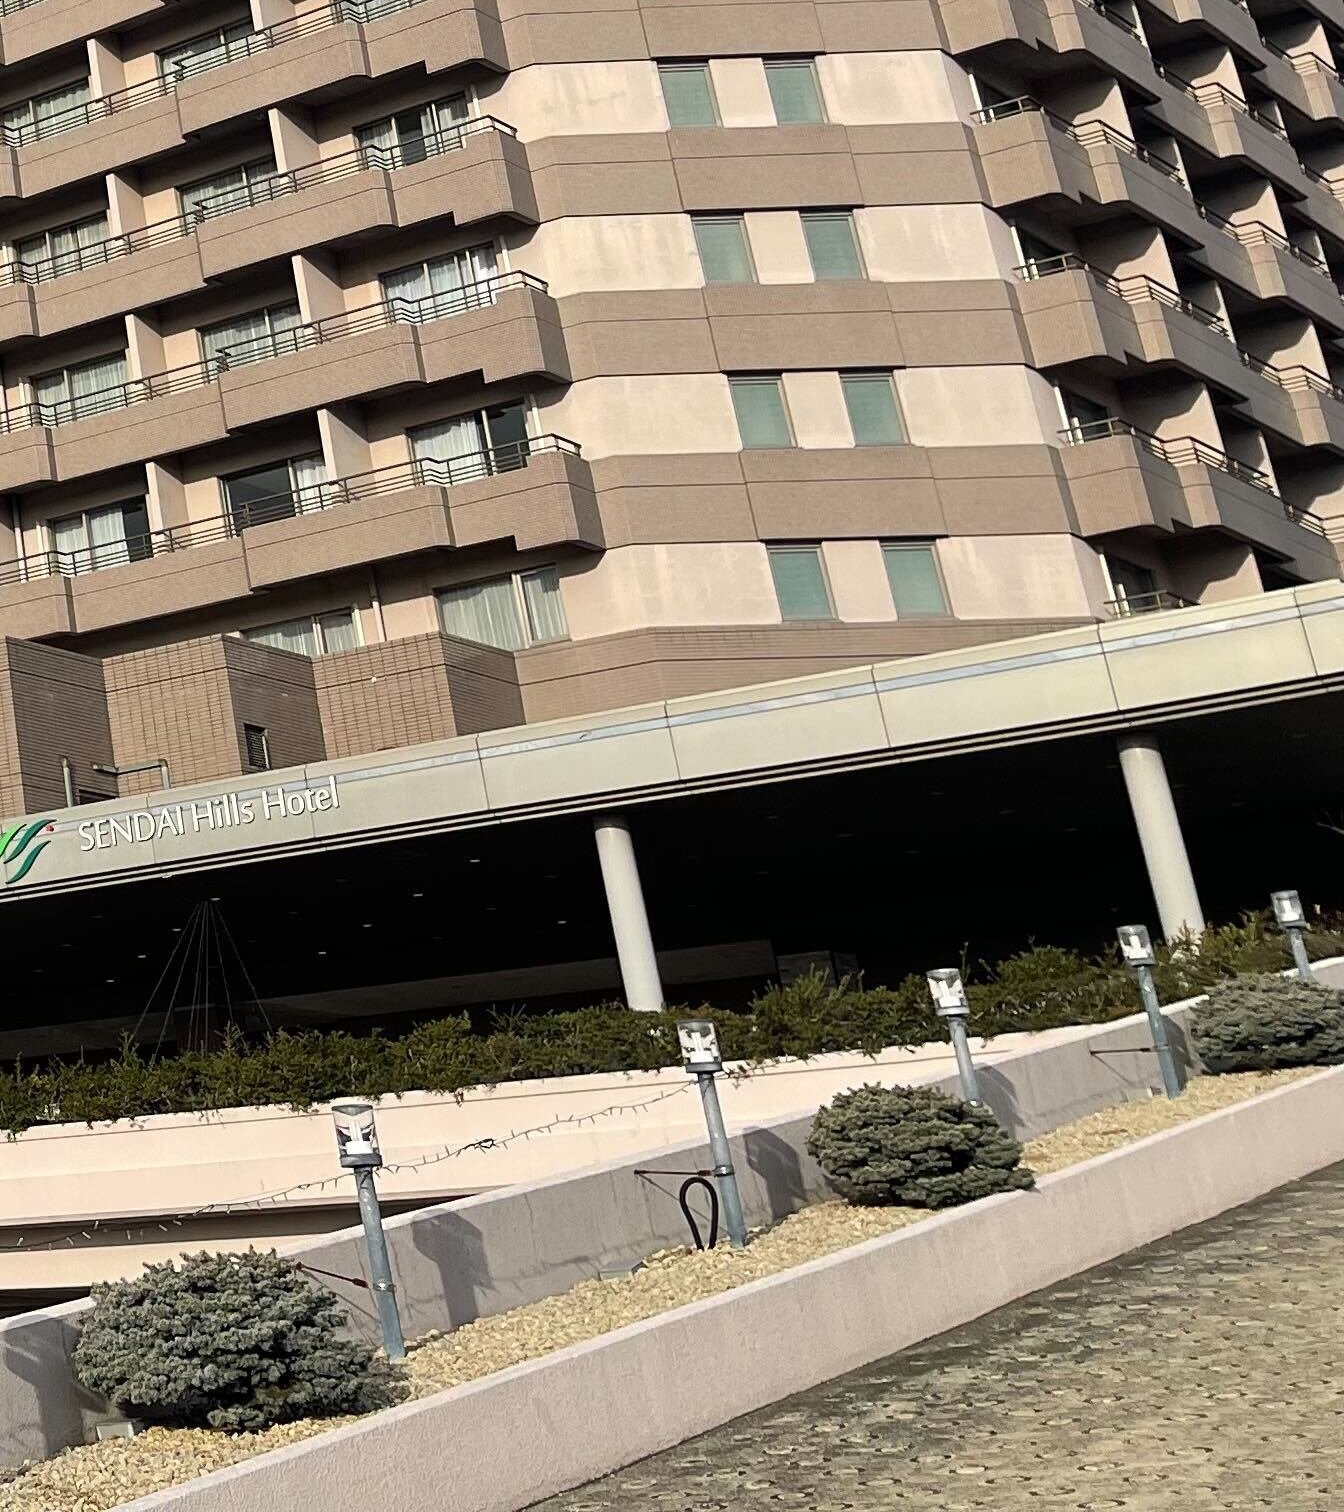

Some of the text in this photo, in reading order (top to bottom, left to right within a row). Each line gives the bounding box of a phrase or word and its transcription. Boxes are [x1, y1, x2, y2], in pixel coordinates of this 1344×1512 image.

[78, 775, 340, 851] SENDAI Hills Hotel
